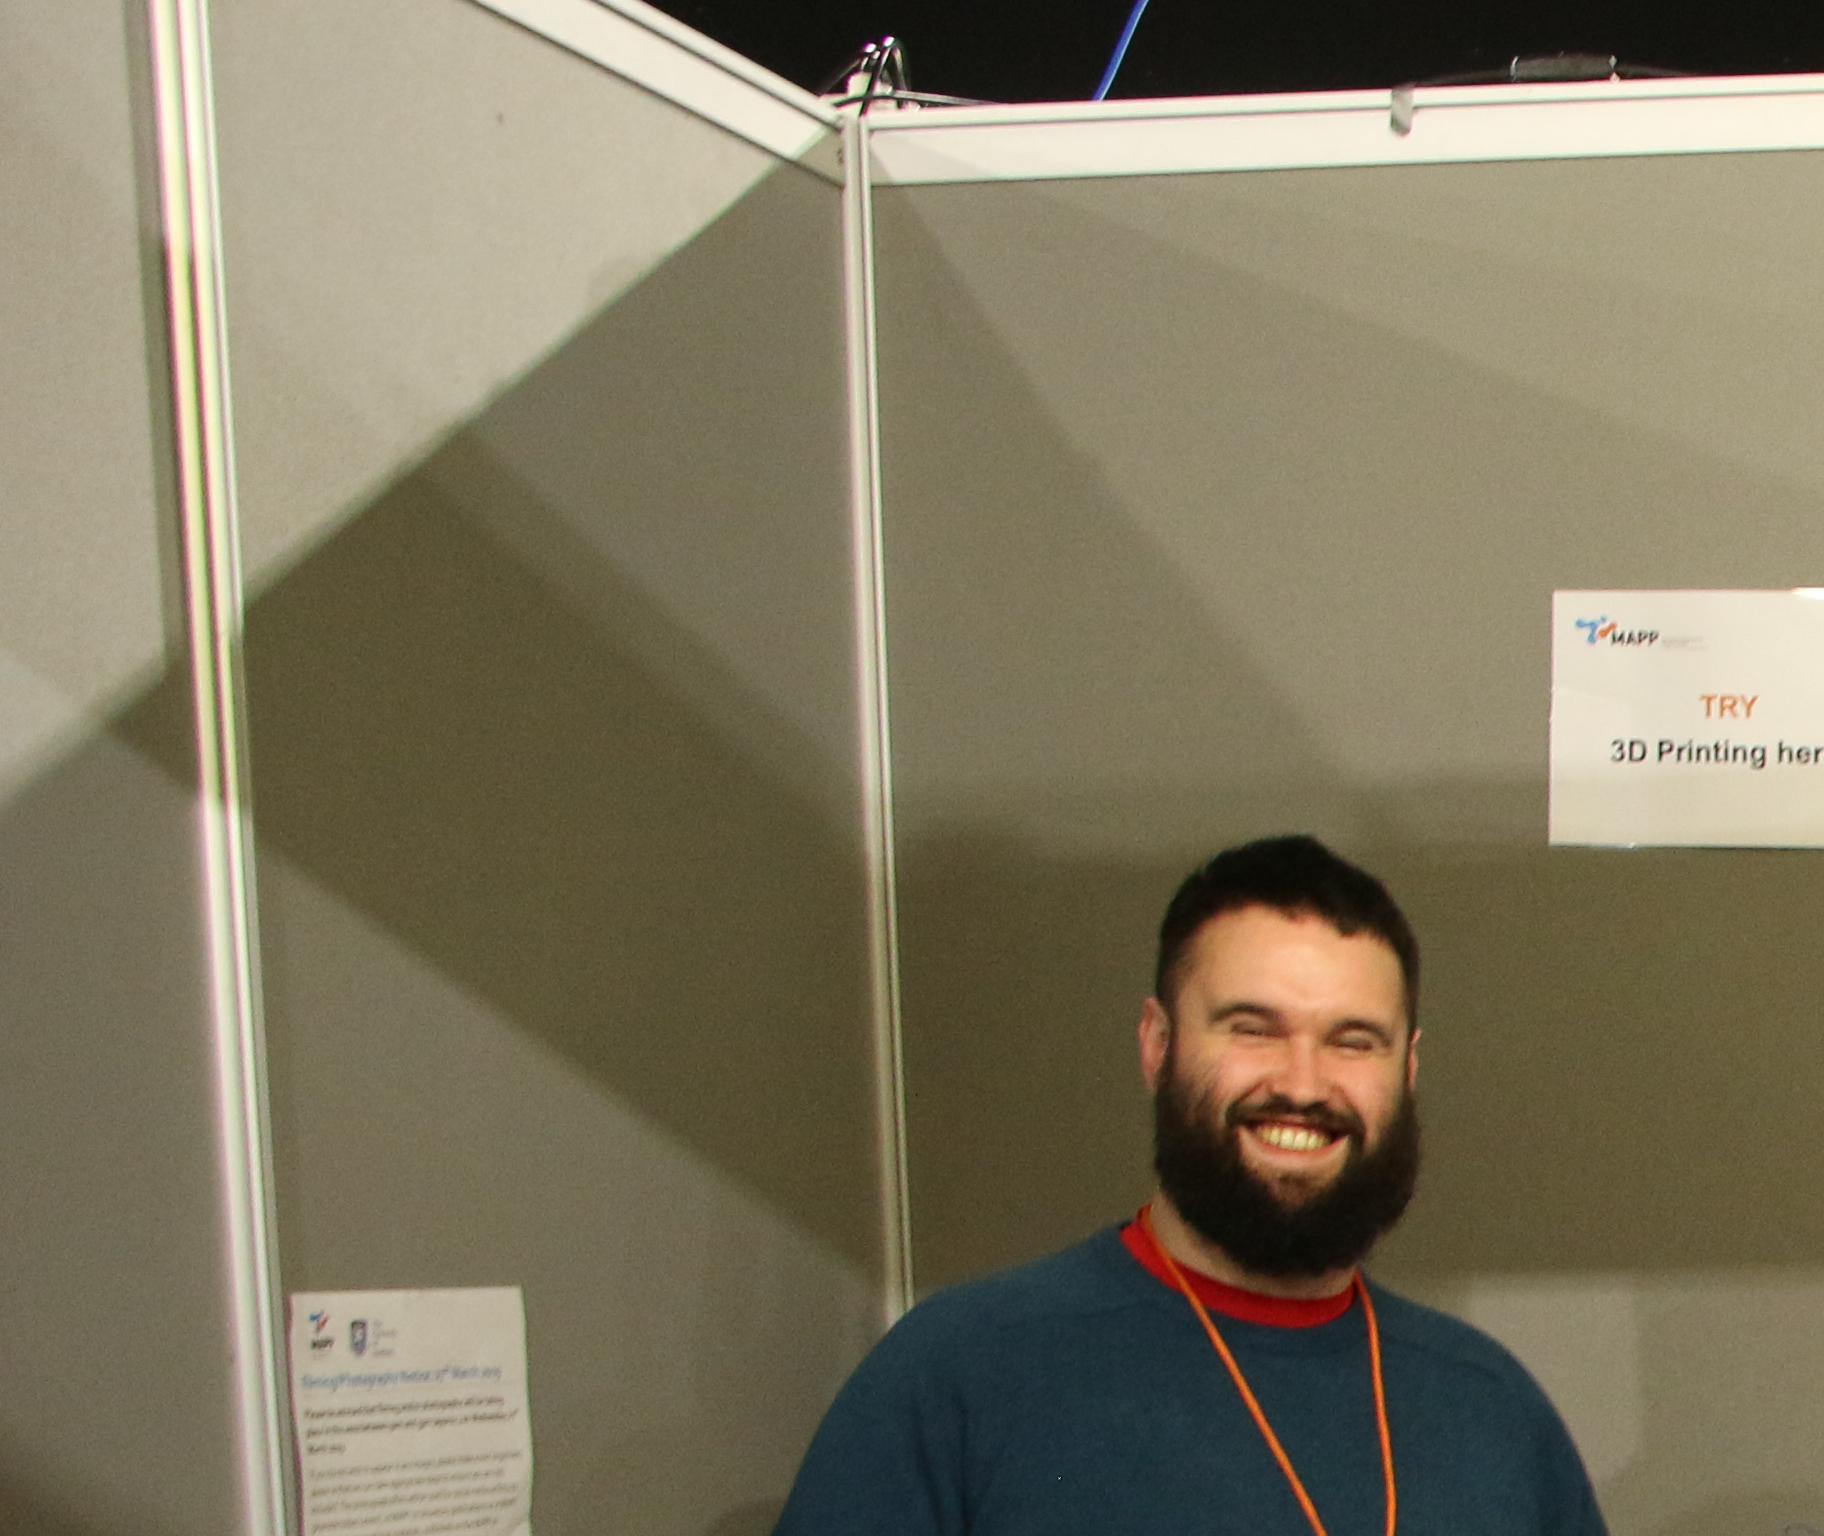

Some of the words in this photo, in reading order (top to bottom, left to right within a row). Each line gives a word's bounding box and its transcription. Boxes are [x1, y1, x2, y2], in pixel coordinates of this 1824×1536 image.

[1611, 631, 1659, 646] MAPP
[1700, 695, 1758, 718] TRY
[1611, 740, 1646, 762] 3D
[1657, 740, 1766, 768] Printing
